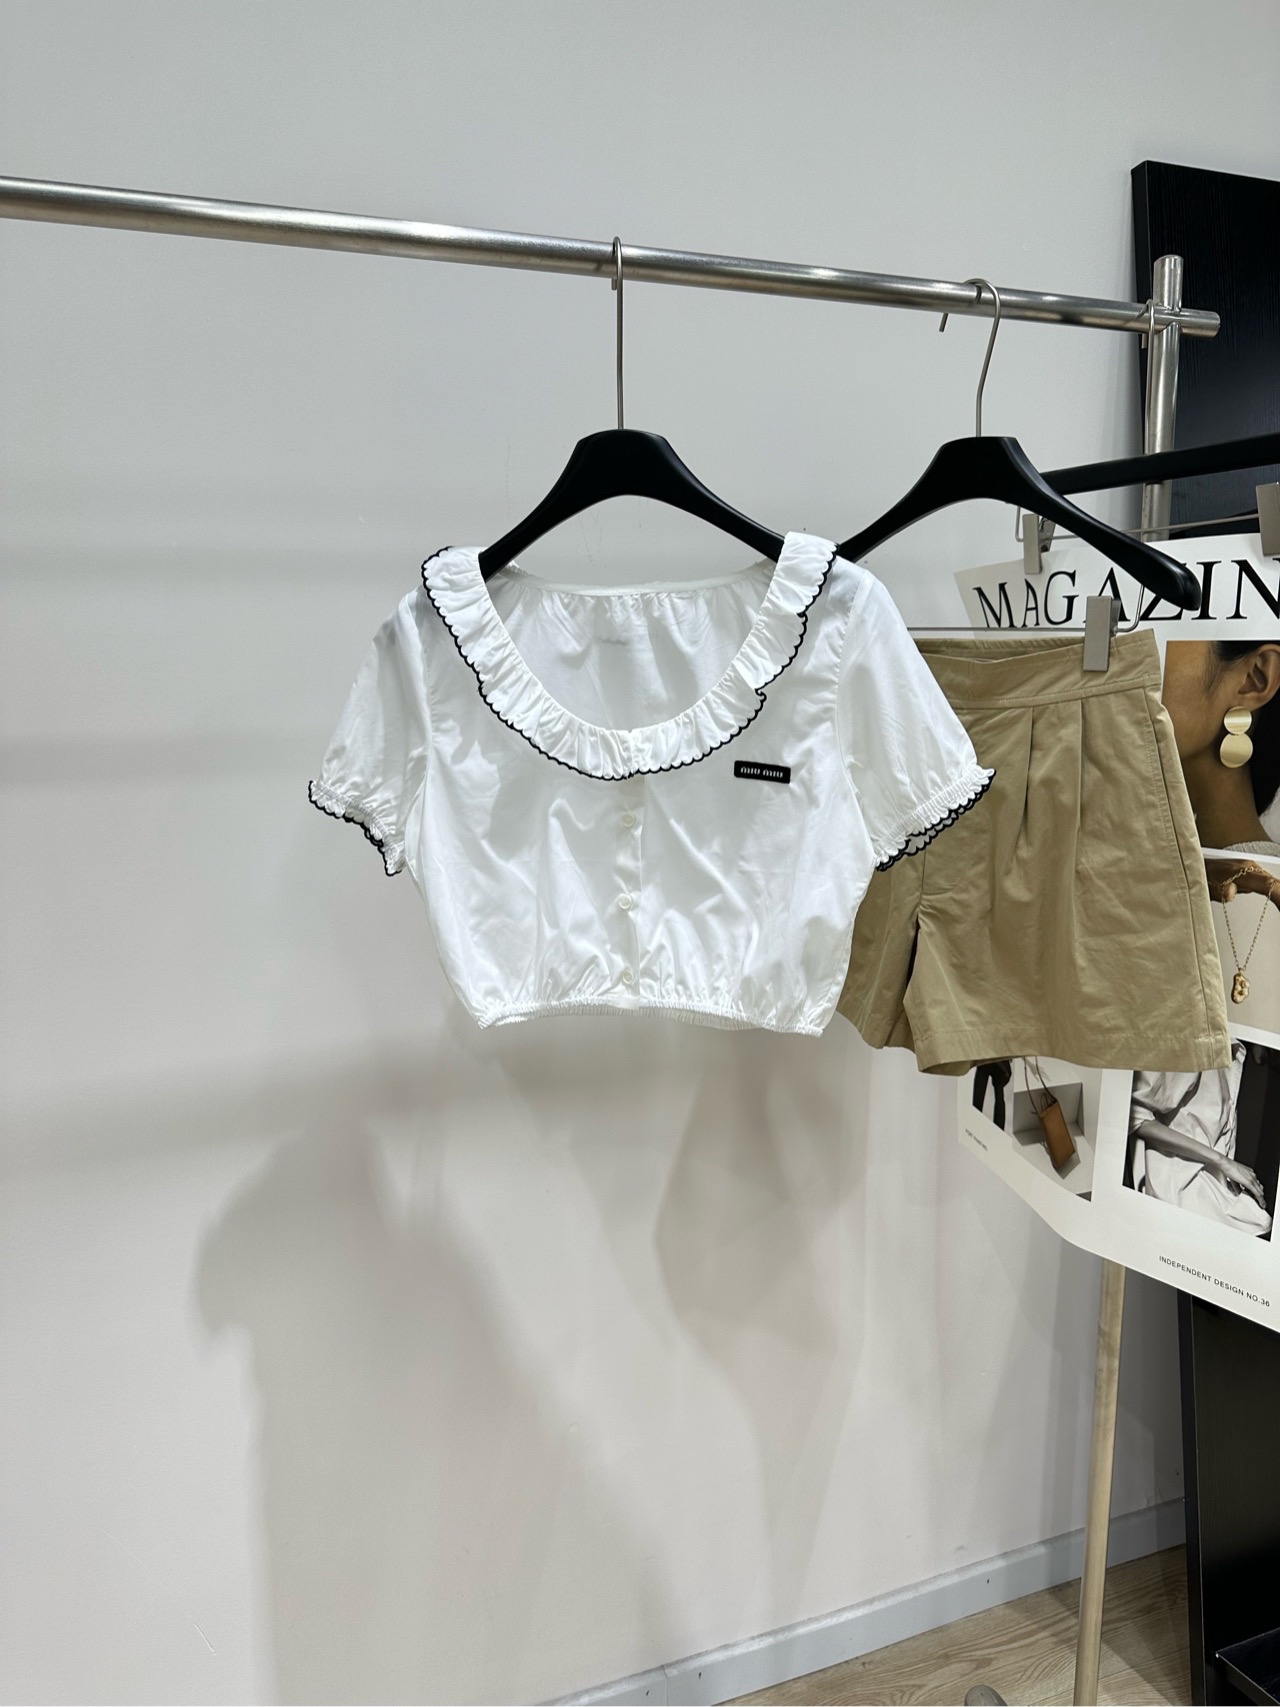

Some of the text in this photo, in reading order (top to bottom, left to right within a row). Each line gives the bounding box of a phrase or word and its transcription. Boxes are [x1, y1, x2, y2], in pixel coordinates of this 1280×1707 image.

[1159, 1255, 1270, 1307] INDEPENDENT DESIGN NO.36
